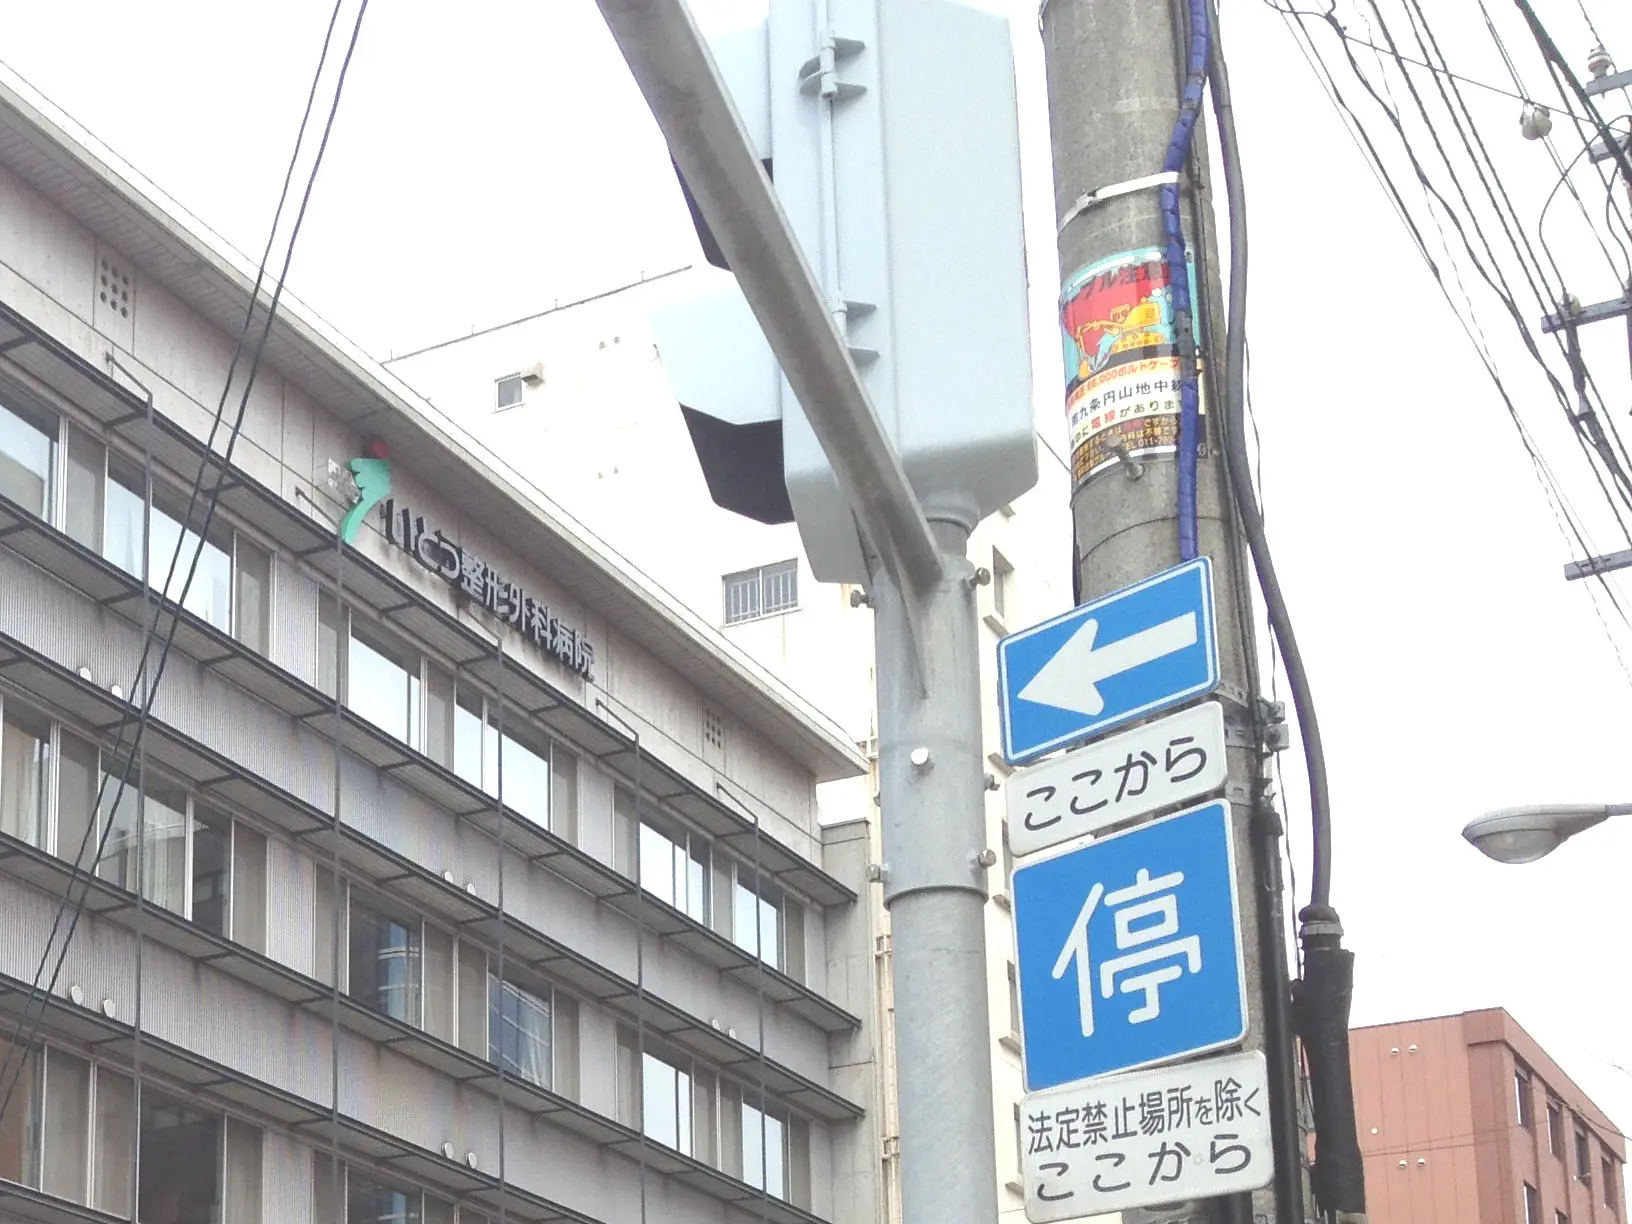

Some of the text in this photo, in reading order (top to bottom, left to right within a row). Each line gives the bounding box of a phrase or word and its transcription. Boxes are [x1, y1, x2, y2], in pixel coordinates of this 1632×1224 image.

[1024, 736, 1207, 832] ここから
[1052, 867, 1202, 1037] 停
[1027, 1076, 1262, 1154] 法定禁止場所を除く
[1037, 1133, 1252, 1202] ここから
